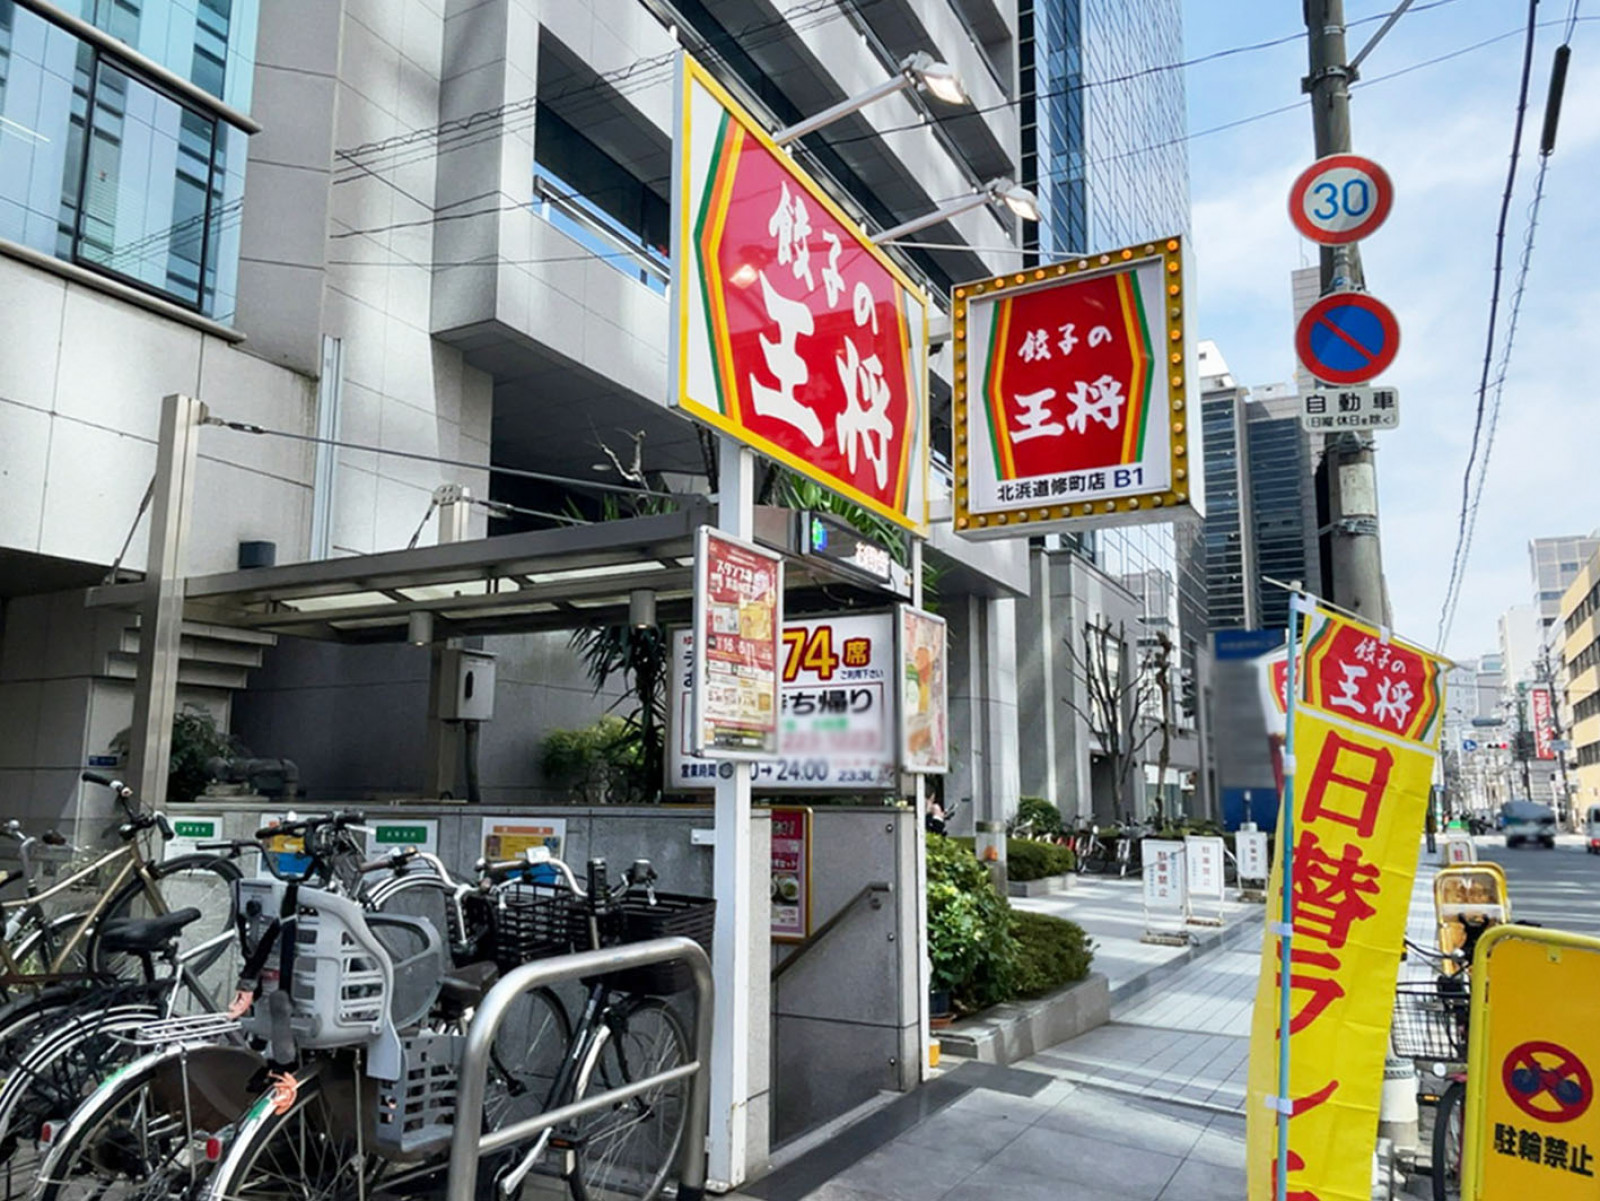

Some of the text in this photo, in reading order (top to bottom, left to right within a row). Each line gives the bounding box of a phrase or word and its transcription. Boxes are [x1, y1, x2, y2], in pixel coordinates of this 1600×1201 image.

[1312, 178, 1370, 220] 30
[768, 180, 880, 336] 餃子の
[1017, 323, 1113, 363] 餃子の
[749, 269, 893, 490] 王将
[1306, 391, 1394, 414] 自動車
[1009, 374, 1126, 444] 王将
[997, 466, 1144, 502] 北浜道修町店 B1
[1354, 637, 1407, 674] 餃子の
[1329, 659, 1414, 730] 王将
[1494, 1123, 1595, 1178] 駐輪禁止
